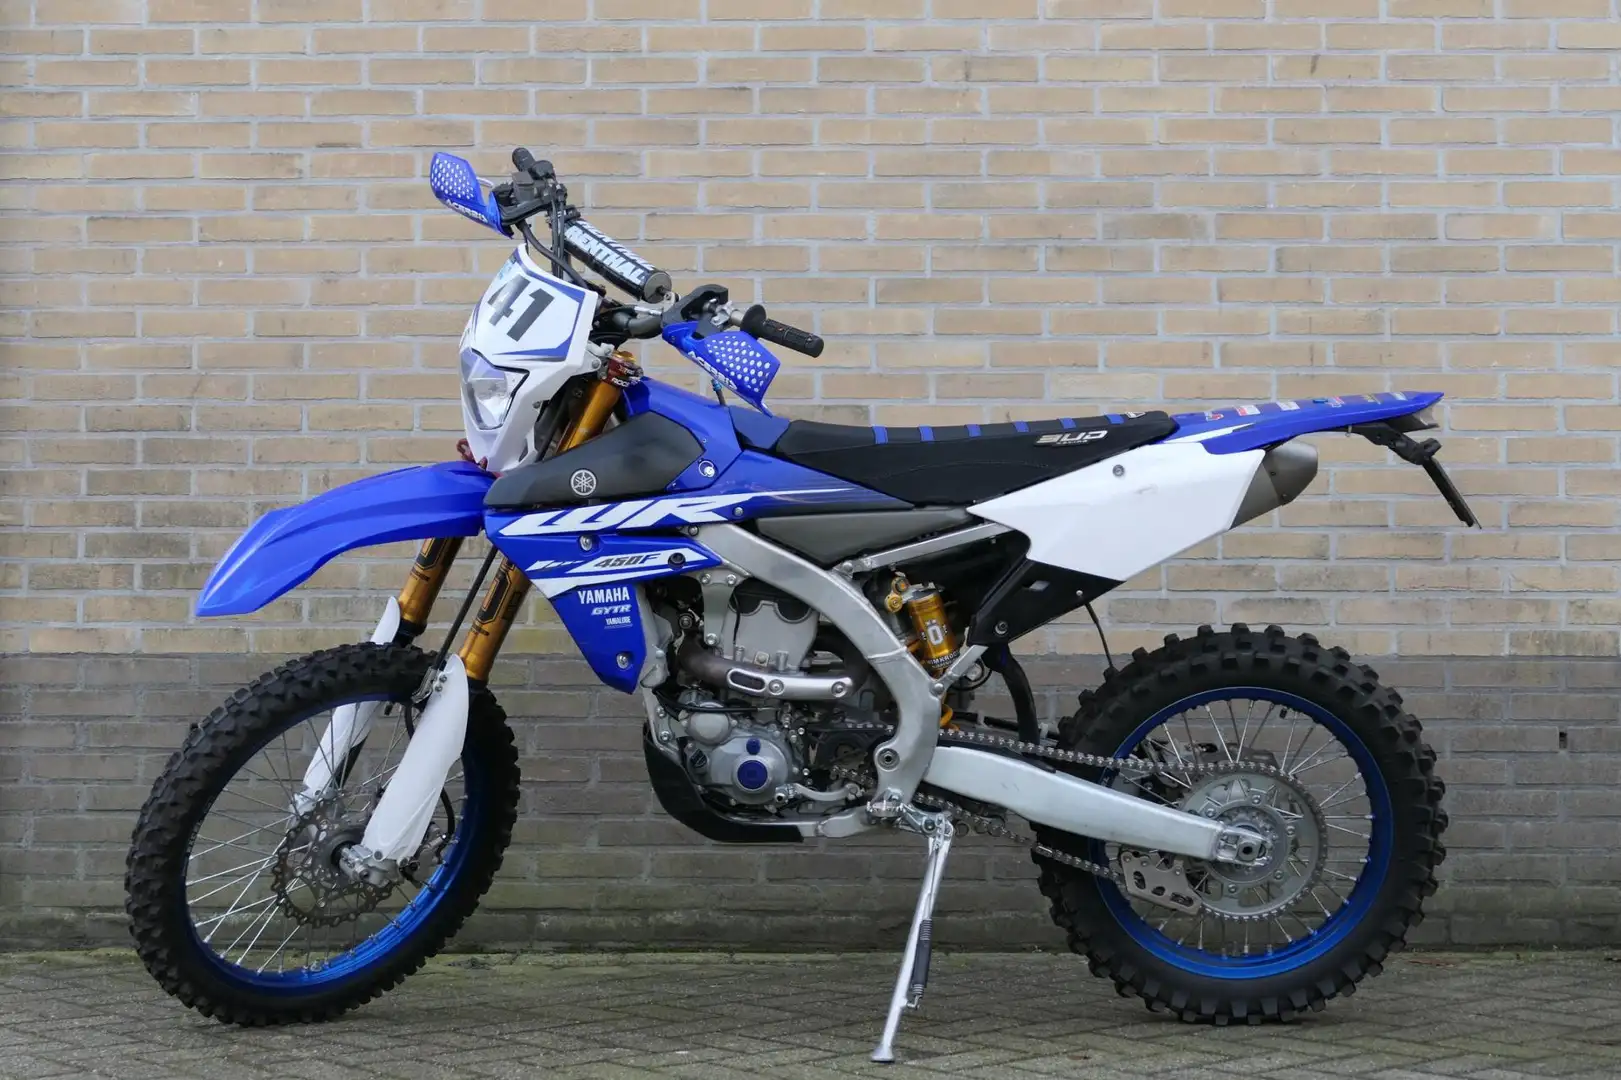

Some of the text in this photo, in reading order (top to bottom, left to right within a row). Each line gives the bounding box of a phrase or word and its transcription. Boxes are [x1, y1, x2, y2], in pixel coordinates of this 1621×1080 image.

[564, 225, 649, 286] RENTHAL
[487, 274, 555, 342] 41
[594, 553, 661, 568] 450F
[577, 586, 630, 605] YAMAHA
[591, 604, 632, 616] GYTR
